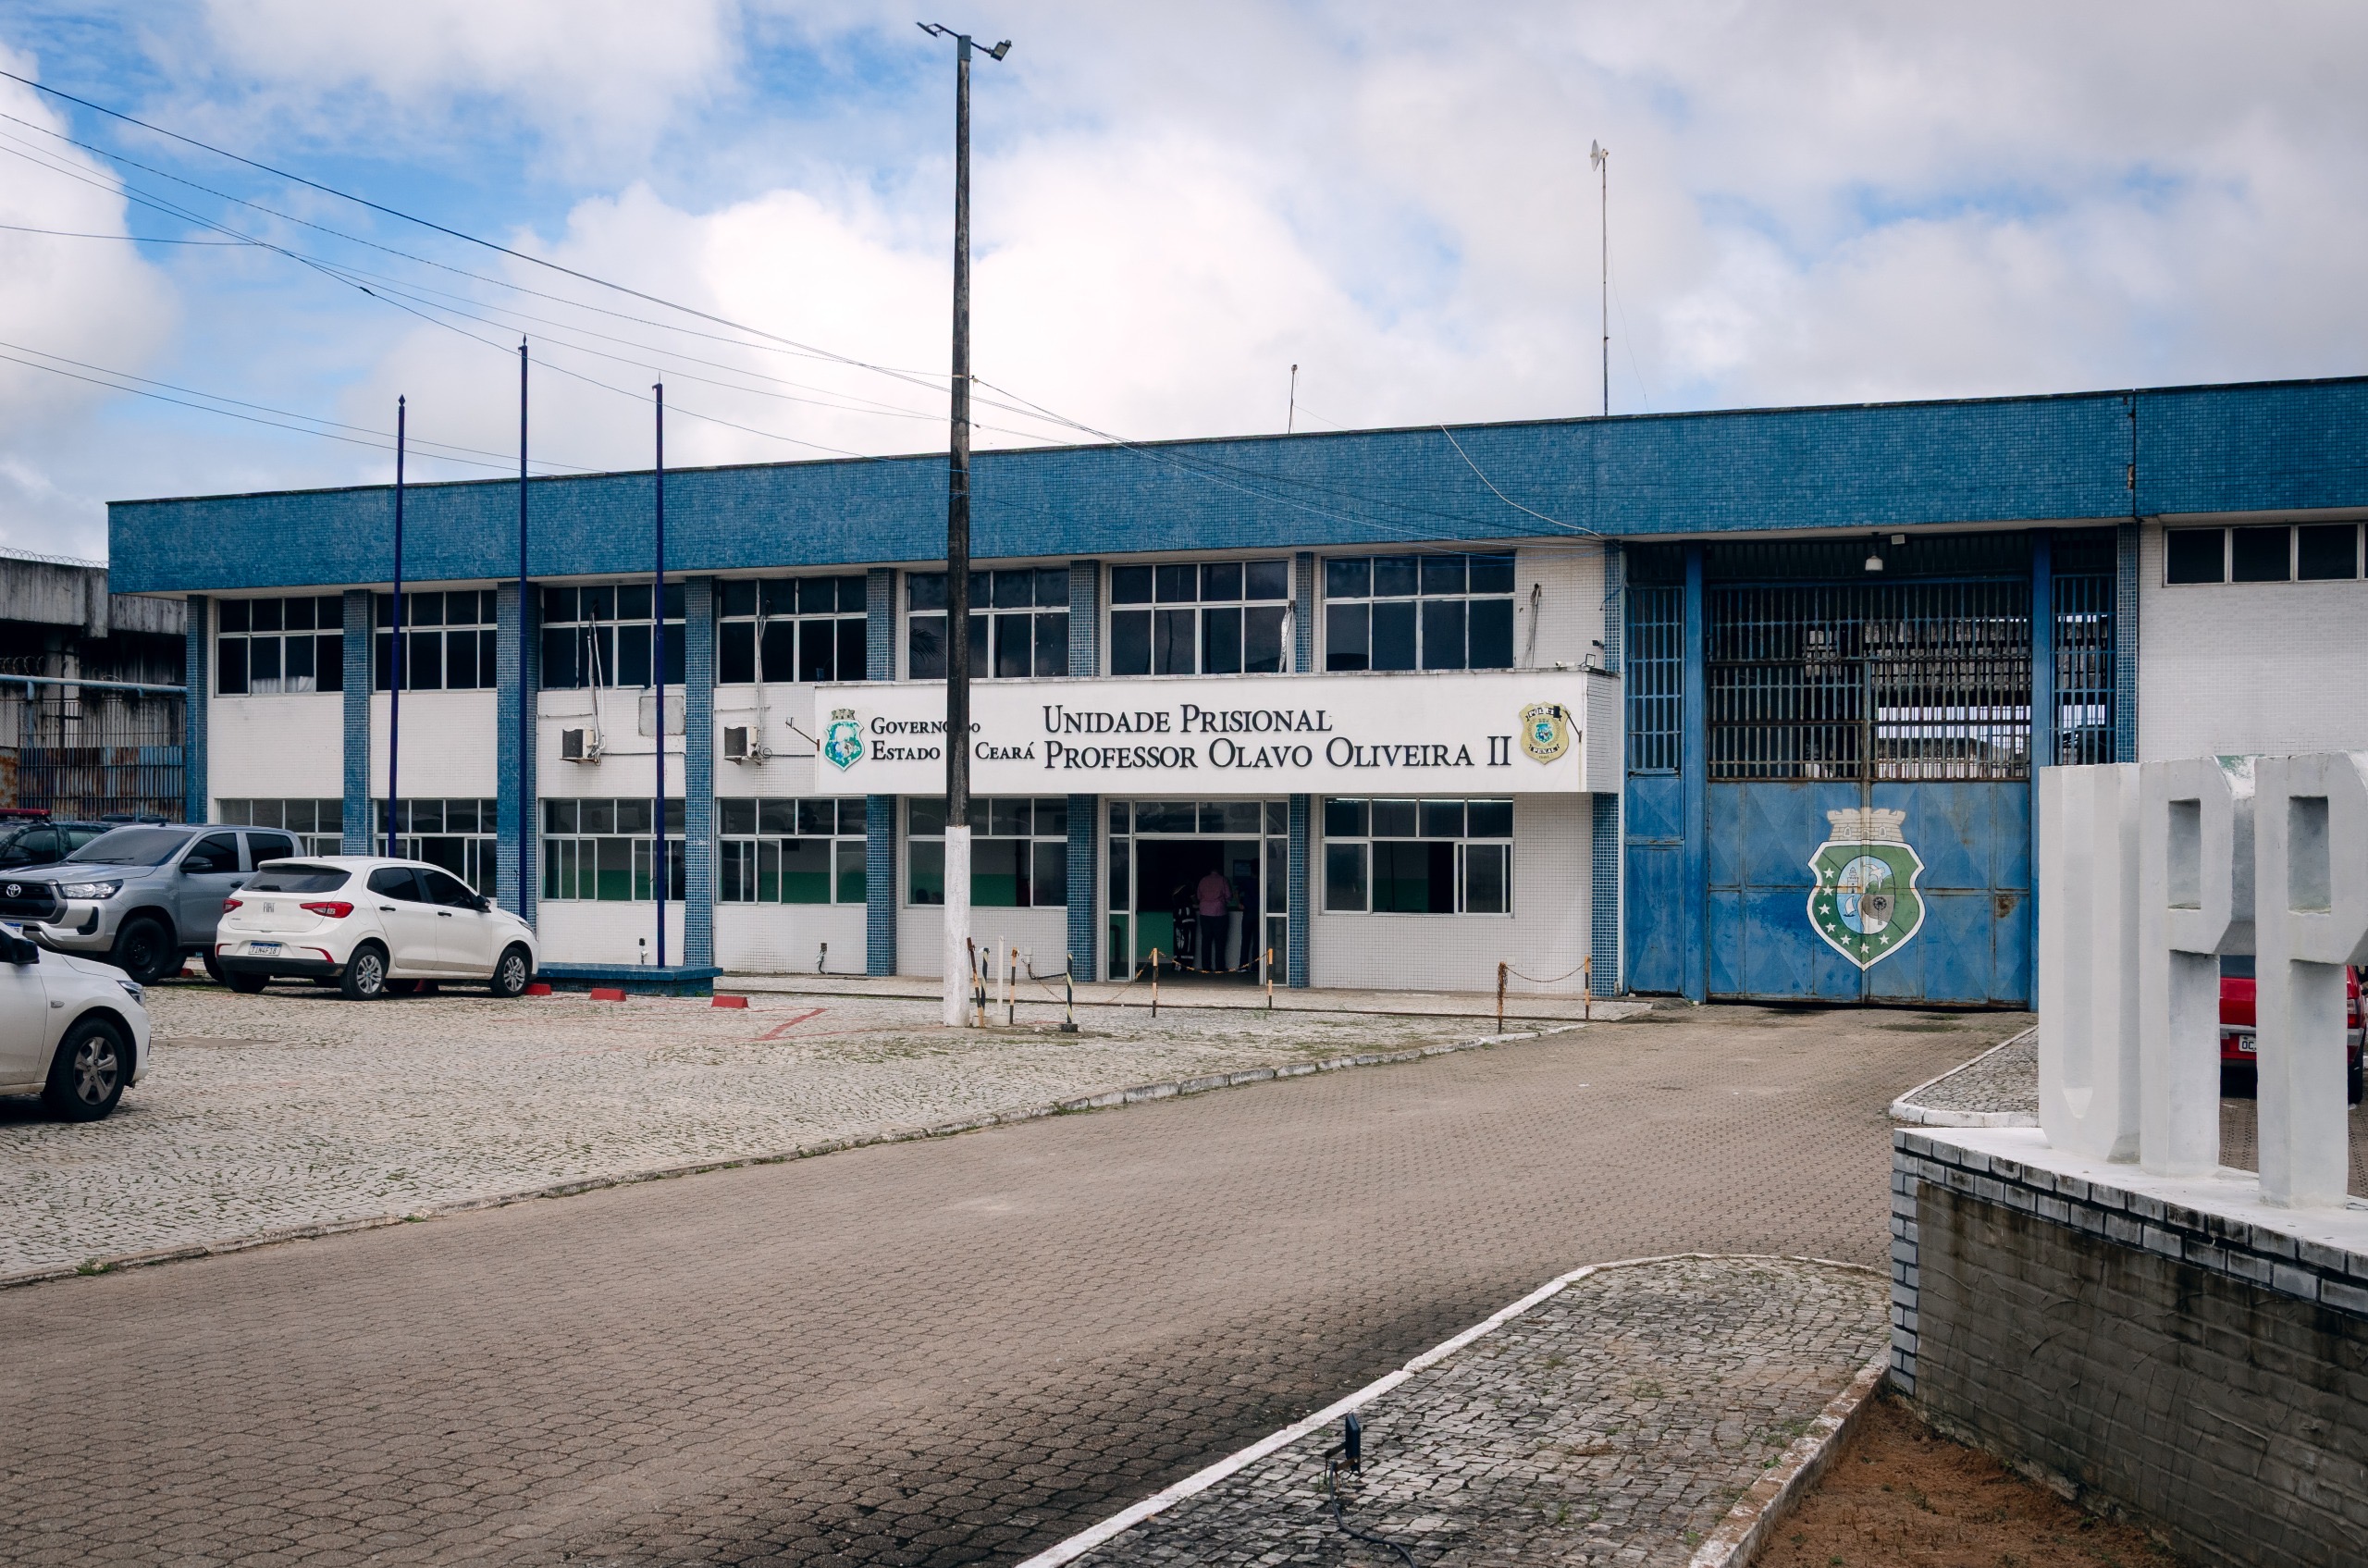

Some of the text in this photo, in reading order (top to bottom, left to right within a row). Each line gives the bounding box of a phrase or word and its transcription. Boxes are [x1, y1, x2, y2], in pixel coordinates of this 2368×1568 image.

[1043, 704, 1333, 734] UNIDADE PRISIONAL
[870, 741, 1035, 760] ESTADO CEARÁ
[1044, 735, 1512, 769] PROFESSOR OLAVO OLIVEIRA II
